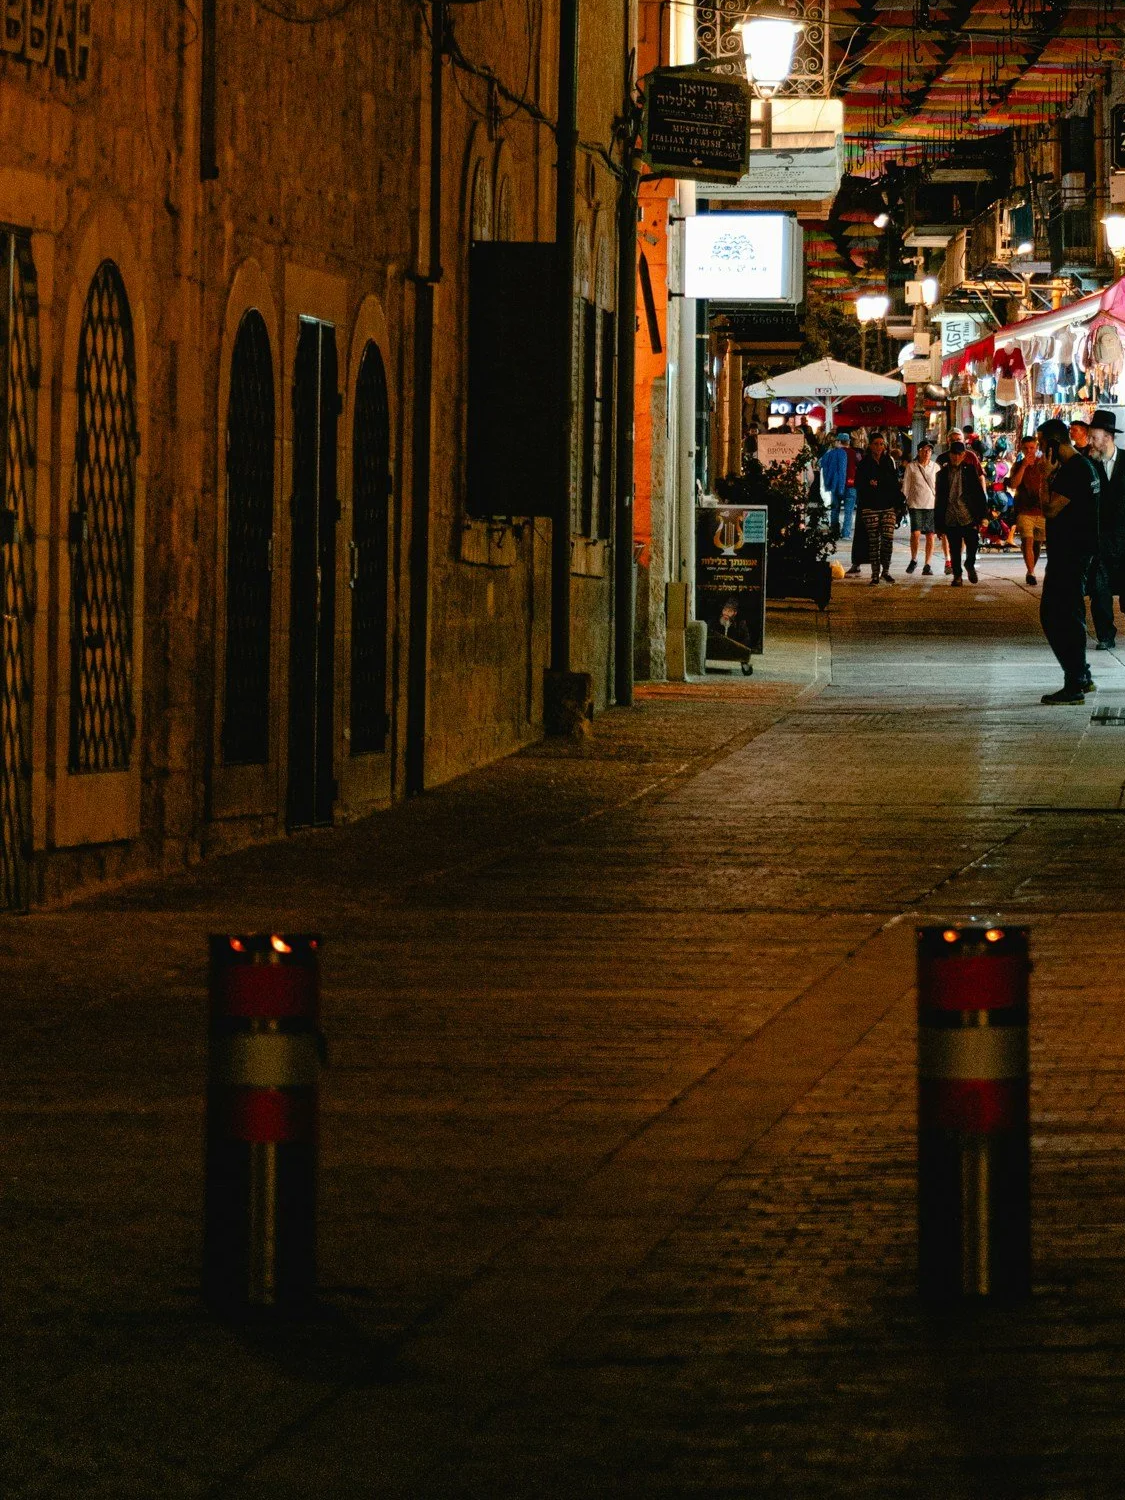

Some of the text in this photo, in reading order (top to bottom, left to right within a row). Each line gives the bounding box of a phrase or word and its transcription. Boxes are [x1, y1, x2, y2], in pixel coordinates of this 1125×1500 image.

[651, 133, 742, 151] ITALIAN JEWISH ART
